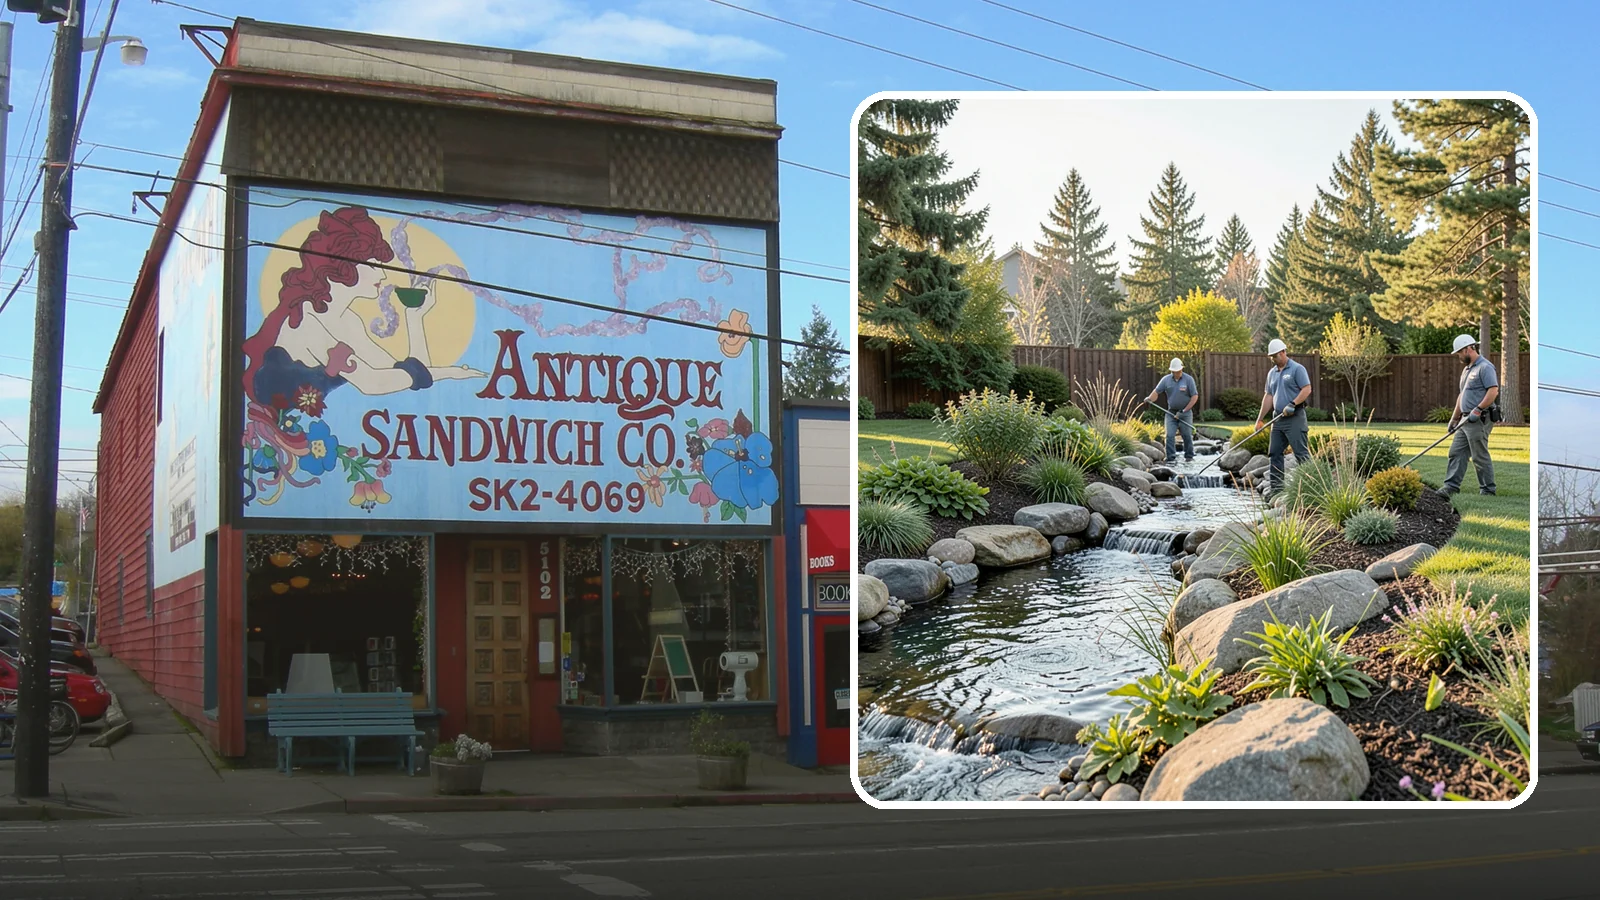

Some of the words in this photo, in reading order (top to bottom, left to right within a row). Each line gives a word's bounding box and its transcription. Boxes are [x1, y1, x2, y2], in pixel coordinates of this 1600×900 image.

[476, 329, 724, 421] ANTIQUE
[361, 408, 604, 468] SANDWICH
[617, 421, 686, 469] CO.
[468, 476, 646, 514] SK2-4069
[539, 541, 552, 600] 5102
[809, 555, 835, 569] BOOKS
